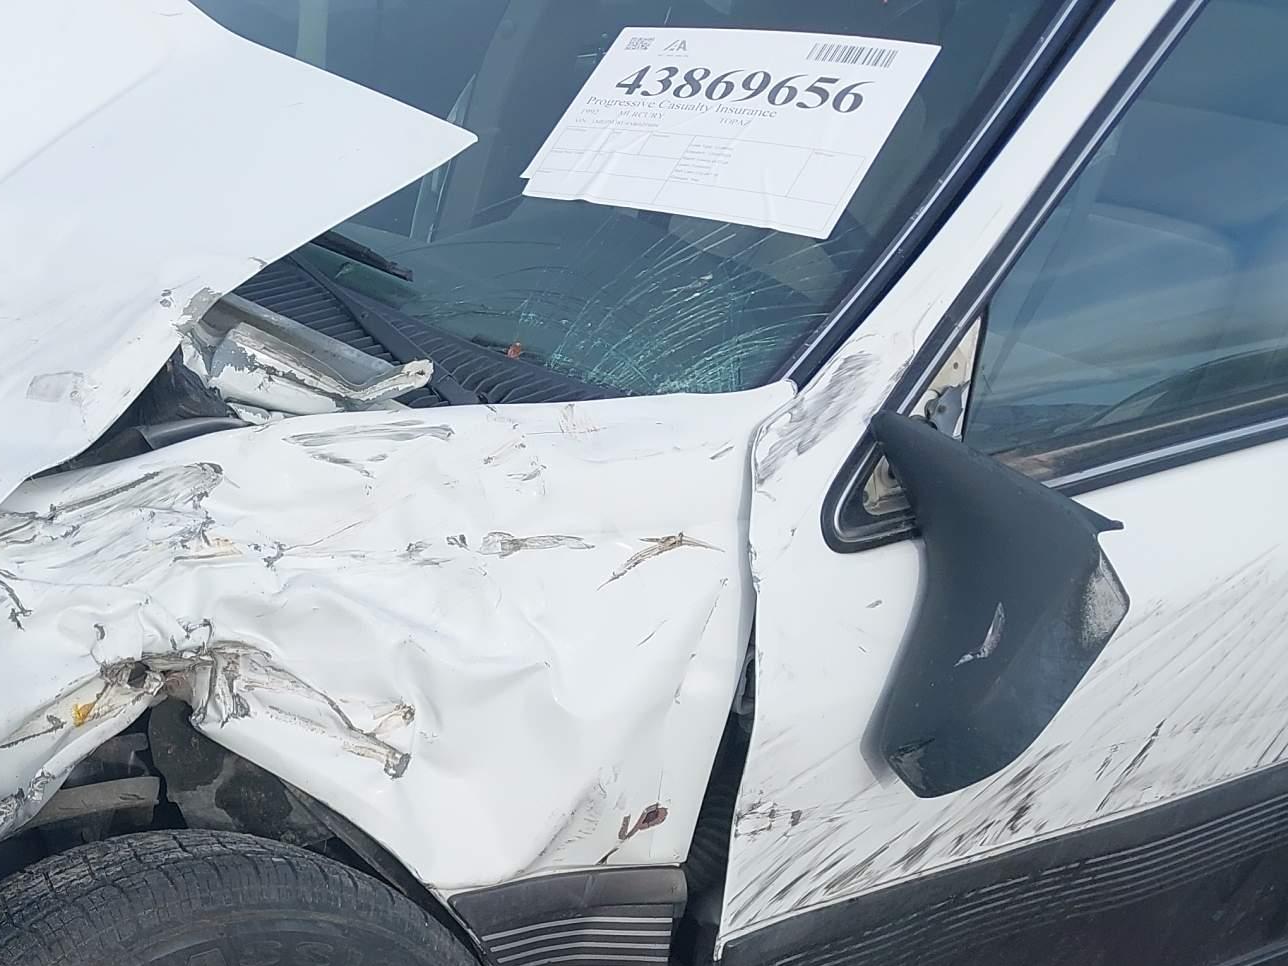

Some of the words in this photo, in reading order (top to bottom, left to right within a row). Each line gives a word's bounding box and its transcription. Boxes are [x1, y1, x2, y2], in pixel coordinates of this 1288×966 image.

[616, 64, 875, 114] 43869656
[585, 95, 656, 110] Progressive
[658, 97, 712, 113] Casualty
[714, 102, 778, 118] Insurance
[618, 109, 665, 120] MERCURY
[719, 118, 752, 127] TOPAZ
